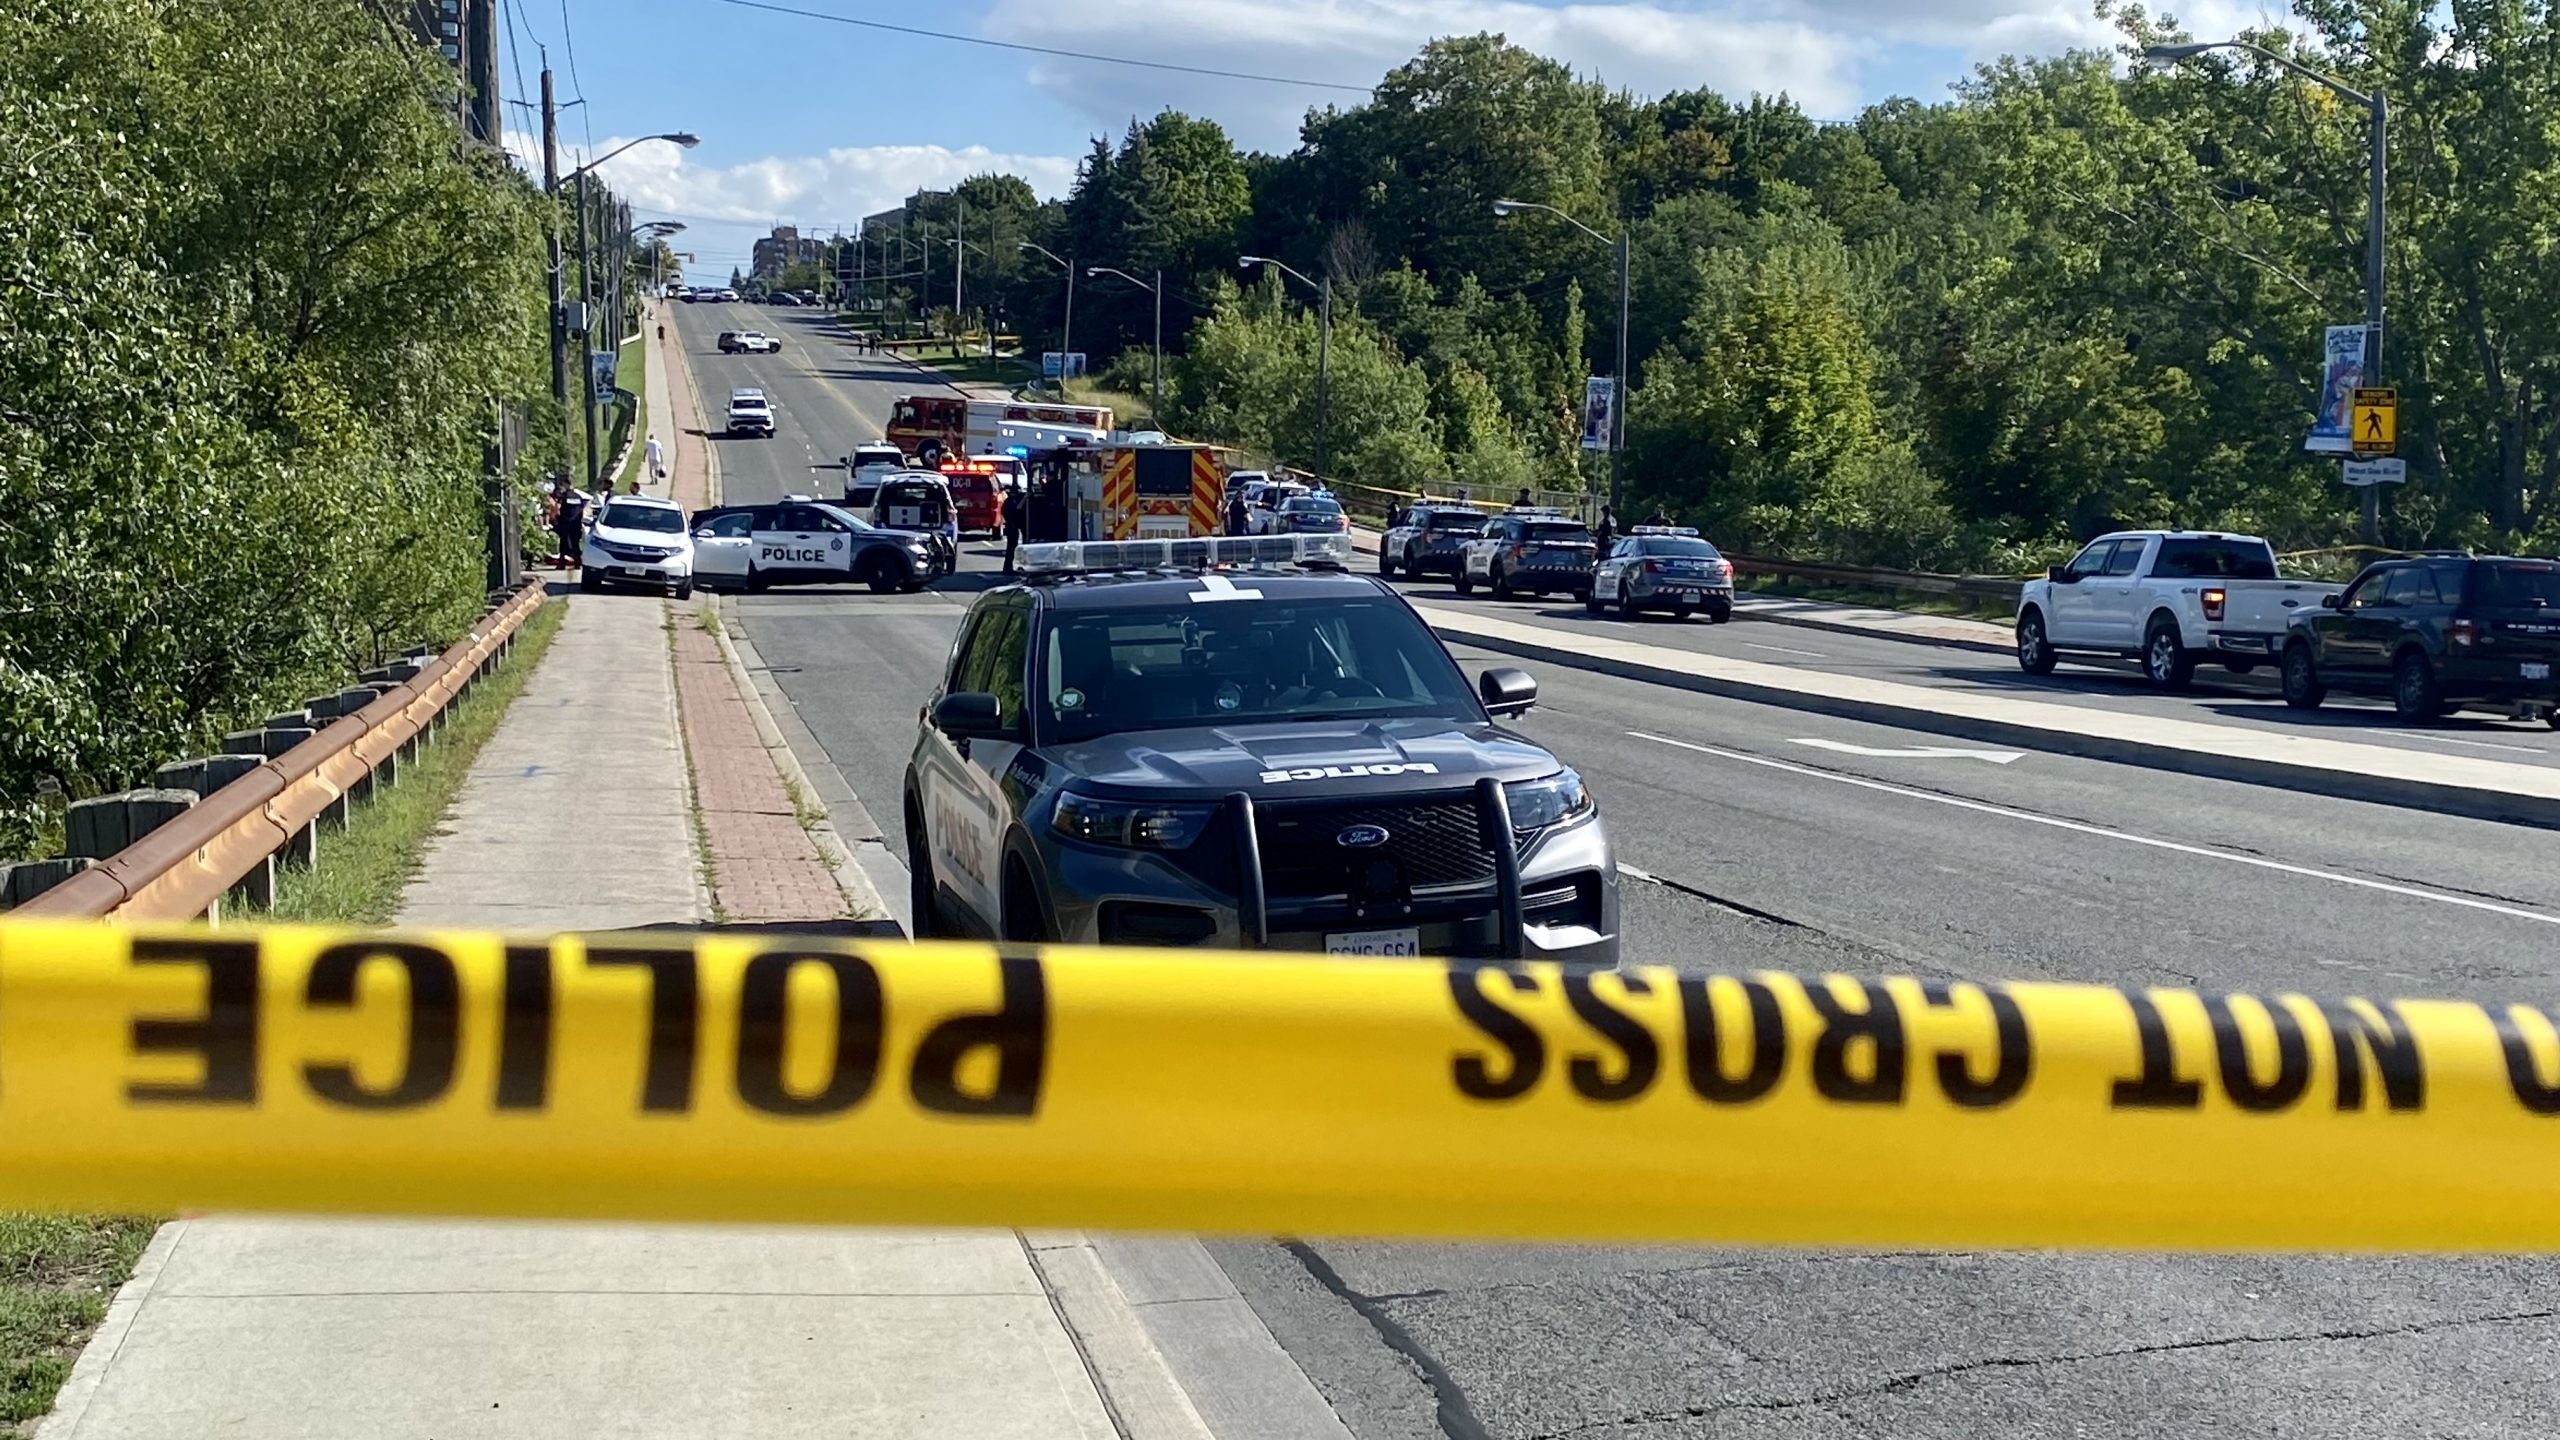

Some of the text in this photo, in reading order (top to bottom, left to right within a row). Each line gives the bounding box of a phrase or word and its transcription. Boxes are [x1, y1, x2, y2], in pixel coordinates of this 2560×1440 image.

[762, 547, 825, 563] POLICE
[1674, 560, 1710, 568] POLICE
[1260, 763, 1438, 783] POLICE
[935, 793, 985, 886] POLICE
[1349, 831, 1378, 844] Ford
[124, 938, 1051, 1120] POLICE
[1446, 966, 2032, 1108] CROSS
[2108, 989, 2427, 1114] NOT
